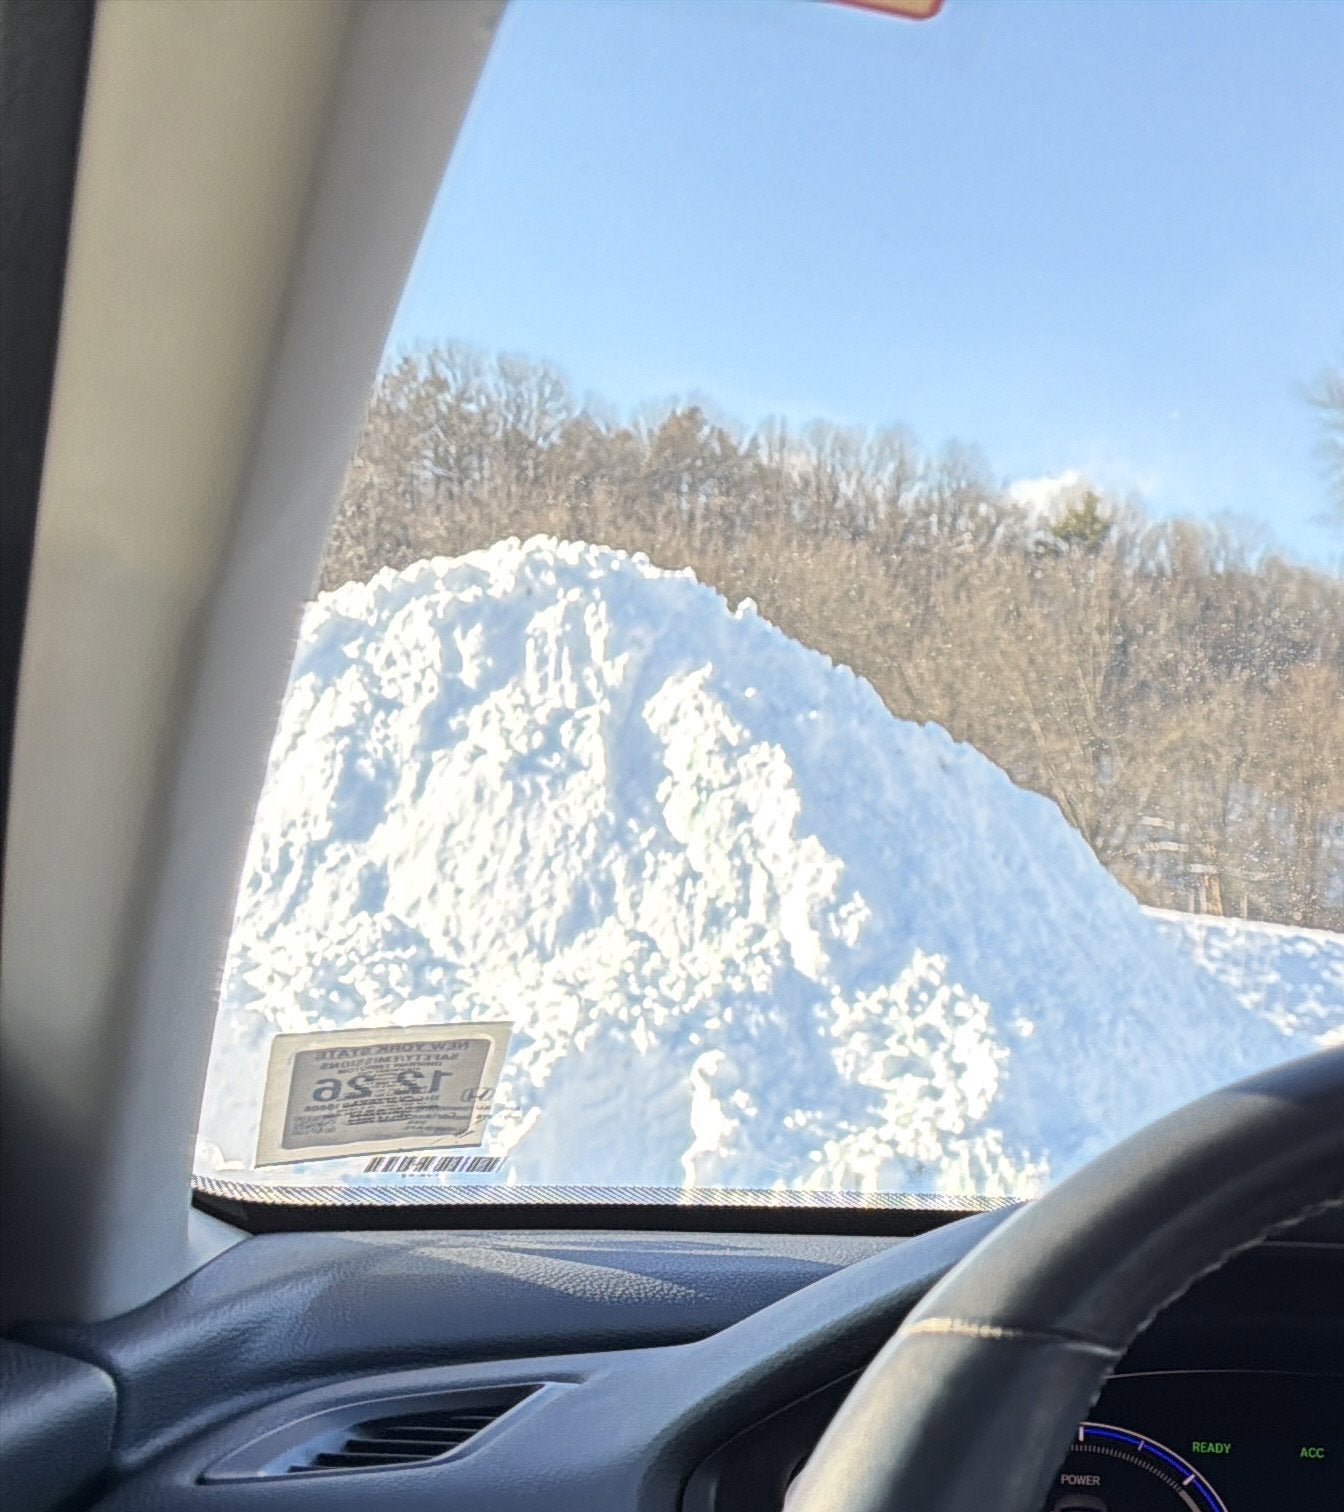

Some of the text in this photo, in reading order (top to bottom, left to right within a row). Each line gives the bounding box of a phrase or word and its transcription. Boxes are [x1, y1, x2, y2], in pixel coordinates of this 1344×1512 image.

[1191, 1441, 1232, 1455] READY
[1299, 1447, 1325, 1459] ACC
[1060, 1474, 1101, 1487] POWER
